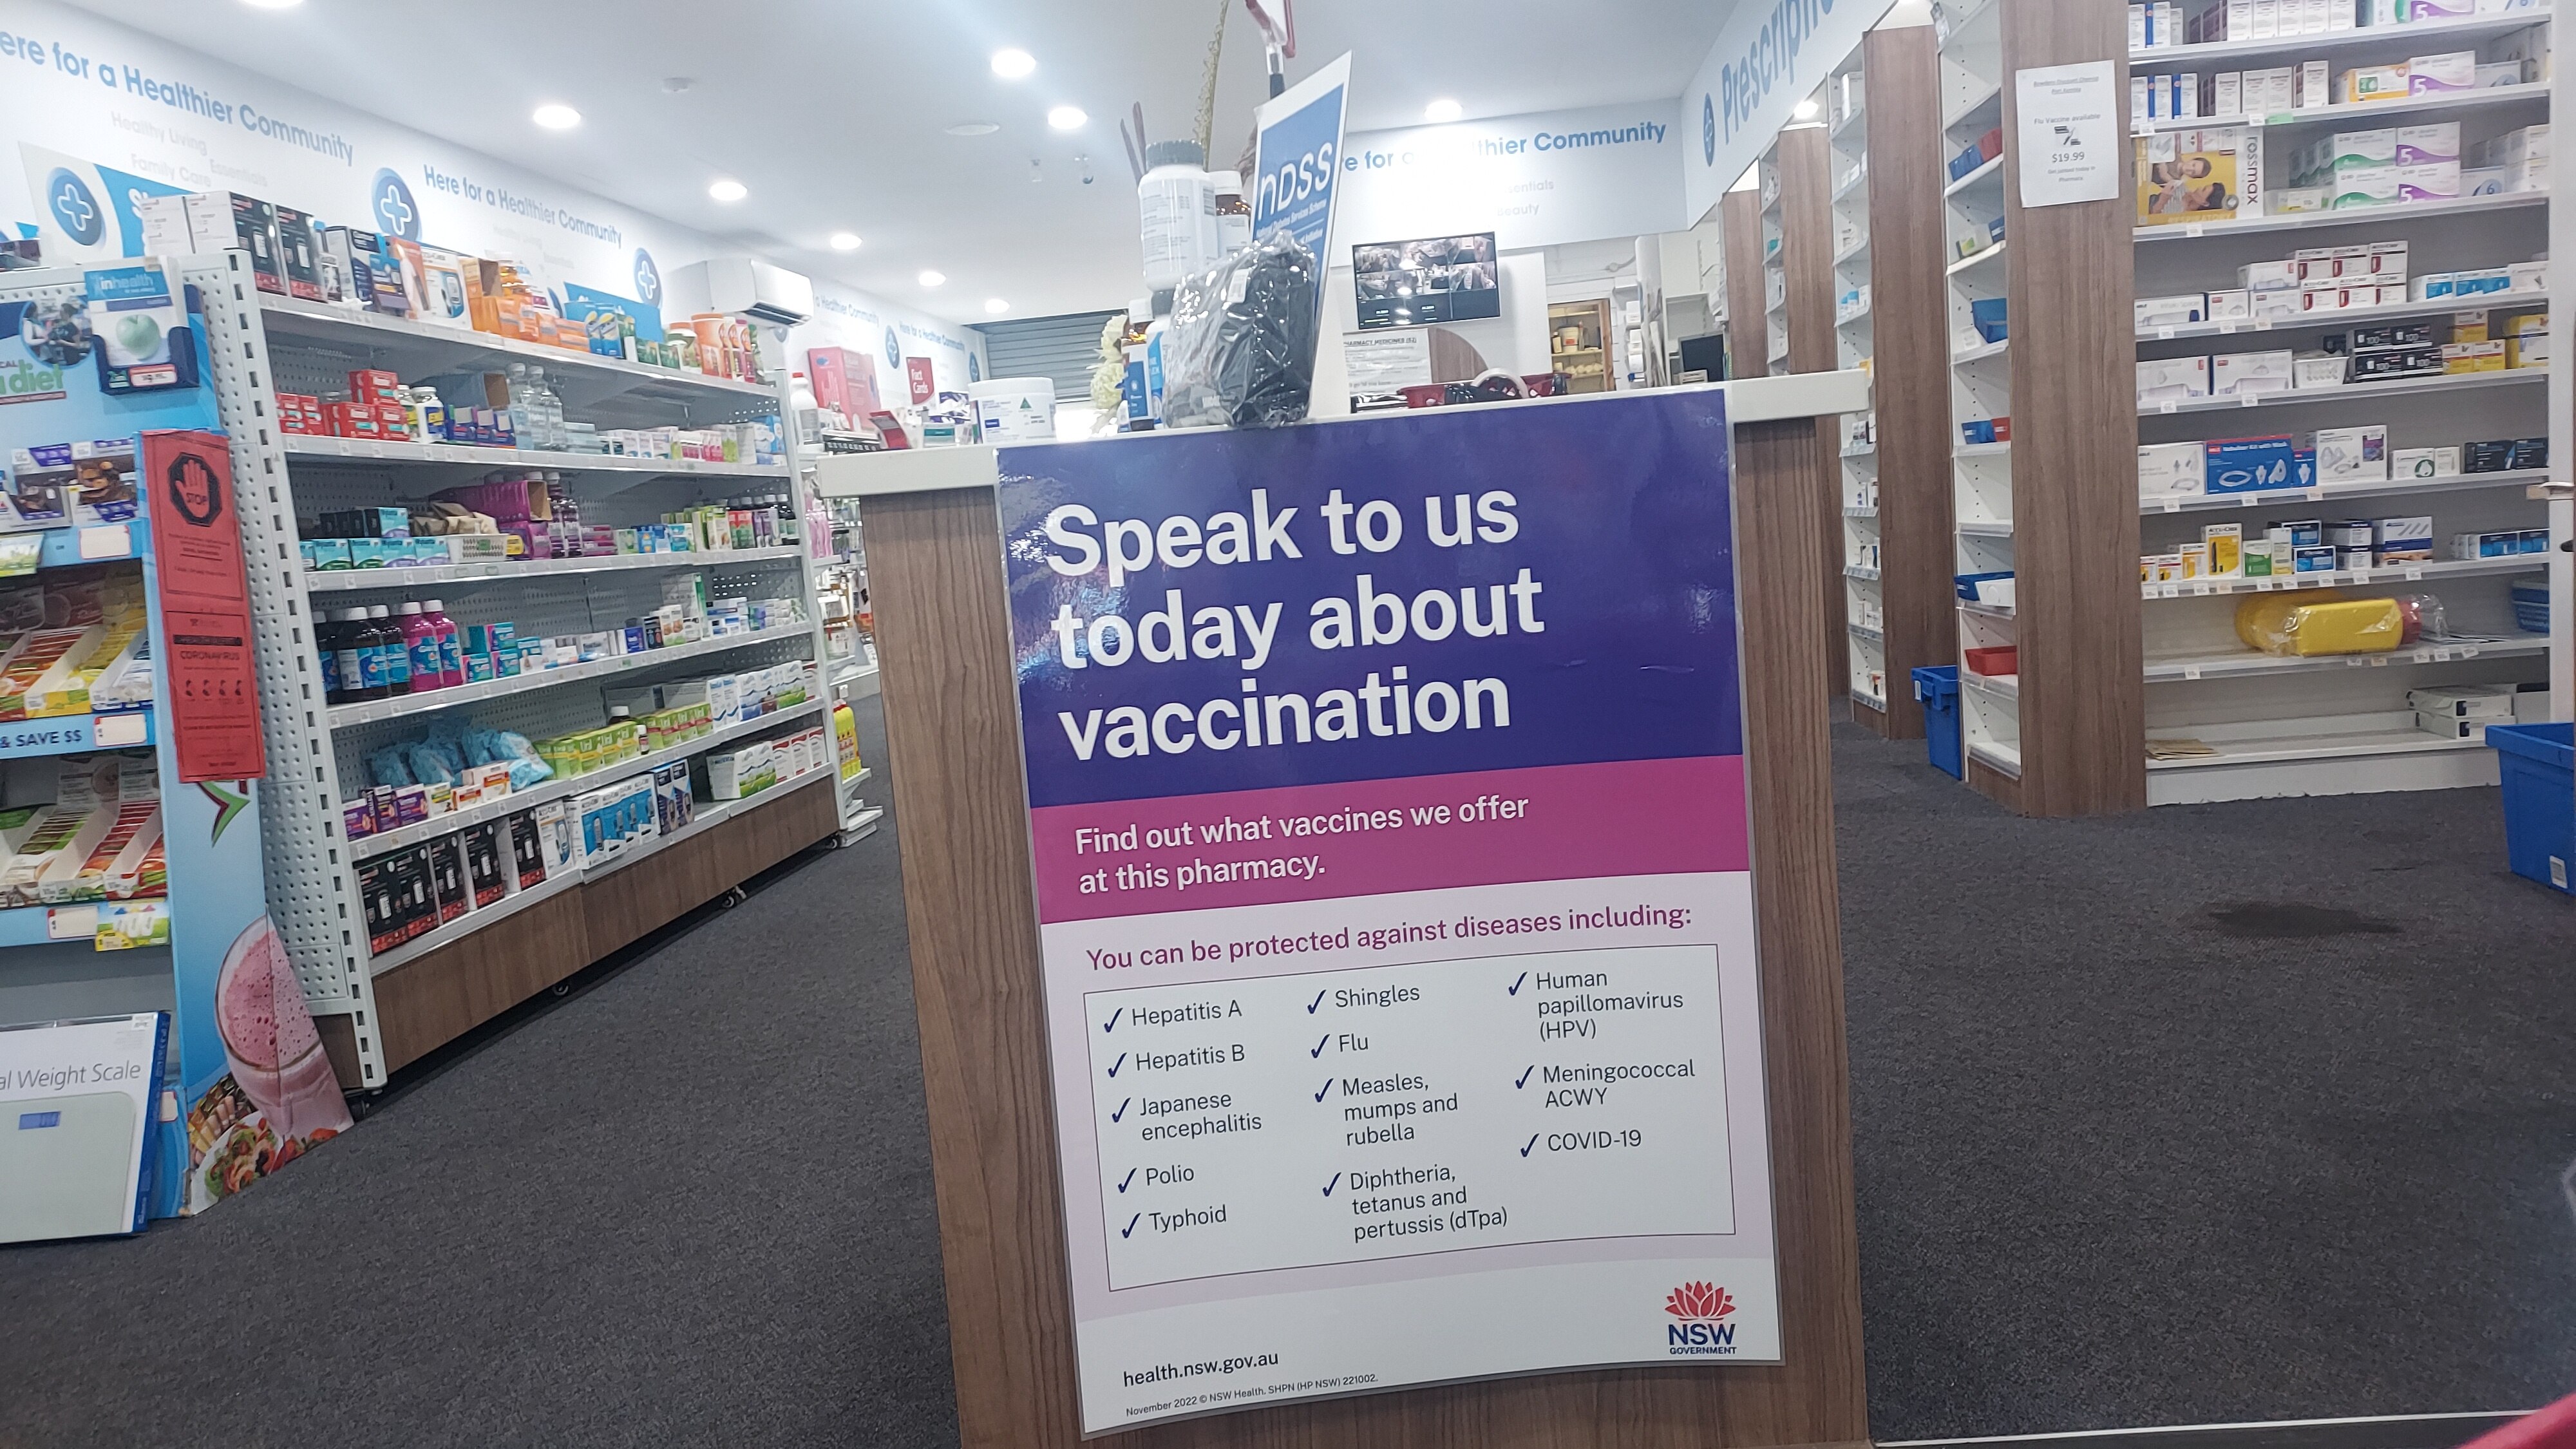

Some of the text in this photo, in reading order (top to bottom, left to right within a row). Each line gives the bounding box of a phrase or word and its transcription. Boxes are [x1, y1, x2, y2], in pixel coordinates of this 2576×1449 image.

[0, 31, 354, 167] ere for a Healthier Community
[2413, 78, 2427, 97] 5
[1364, 150, 1394, 170] for
[1533, 120, 1667, 153] Community
[2052, 151, 2085, 163] $19.99
[2400, 148, 2414, 166] 5
[2246, 136, 2259, 205] rossmax
[423, 164, 460, 195] Here
[462, 177, 482, 203] for
[486, 189, 496, 207] a
[498, 188, 555, 225] Healthier
[558, 209, 622, 250] Community
[2401, 187, 2414, 205] 5
[1046, 488, 1520, 587] Speak to us
[1050, 567, 1546, 670] today about
[179, 650, 241, 661] CORONAVIRUS
[1058, 665, 1511, 761] vaccination
[0, 736, 11, 748] &
[15, 731, 59, 748] SAVE
[1074, 794, 1530, 855] Find out what vaccines we offer
[1078, 853, 1327, 895] at this pharmacy.
[1086, 904, 1692, 971] You can be protected against diseases including:
[1535, 970, 1608, 991] Human
[1334, 984, 1421, 1009] Shingles
[1537, 990, 1684, 1019] papillomavirus
[1132, 999, 1243, 1028] Hepatitis A
[1338, 1033, 1370, 1053] Flu
[1539, 1018, 1597, 1043] (HPV)
[1135, 1043, 1245, 1072] Hepatitis B
[17, 1065, 87, 1090] Weight
[91, 1061, 142, 1081] Scale
[1342, 1074, 1430, 1097] Measles,
[1542, 1059, 1696, 1085] Meningococcal
[1139, 1094, 1233, 1117] Japanese
[1344, 1094, 1459, 1122] mumps and
[1544, 1087, 1608, 1109] ACWY
[1141, 1113, 1262, 1142] encephalitis
[1345, 1123, 1416, 1147] rubella
[1547, 1130, 1642, 1153] COVID-19
[1145, 1164, 1195, 1186] Polio
[1349, 1164, 1457, 1192] Diphtheria,
[1351, 1186, 1468, 1215] tetanus and
[1148, 1204, 1227, 1233] Typhoid
[1354, 1206, 1508, 1244] pertussis (dTpa)
[1668, 1323, 1736, 1346] NSW
[1669, 1346, 1738, 1355] GOVERNMENT
[1123, 1352, 1280, 1388] health.nsw.gov.au
[1126, 1401, 1172, 1417] November
[1174, 1396, 1198, 1408] 2022
[1209, 1390, 1232, 1402] NSW
[1234, 1387, 1267, 1400] Health.
[1267, 1383, 1296, 1394] SHPN
[1296, 1380, 1314, 1392] (HP
[1315, 1377, 1341, 1389] NSW)
[1343, 1373, 1379, 1386] 221002.
